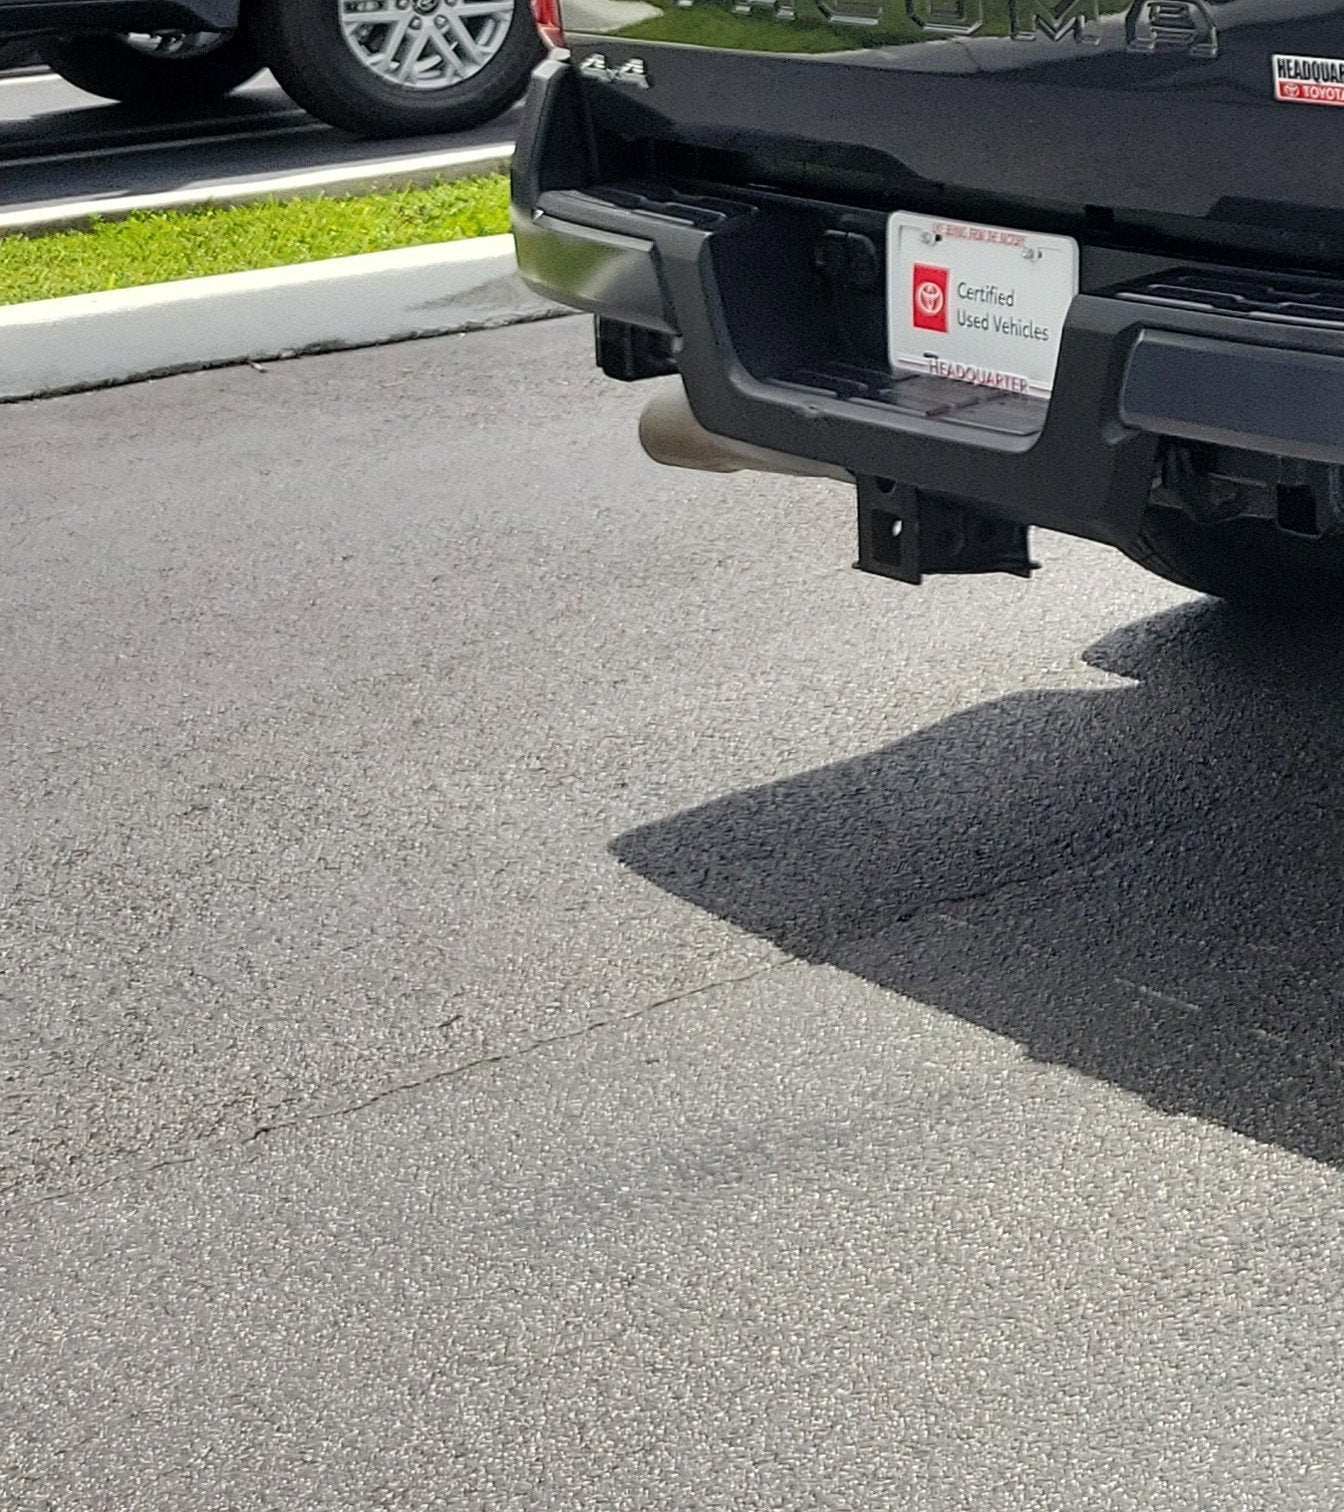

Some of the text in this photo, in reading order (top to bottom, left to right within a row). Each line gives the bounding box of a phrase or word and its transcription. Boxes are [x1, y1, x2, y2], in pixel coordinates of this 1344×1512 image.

[957, 281, 1015, 307] Certified
[957, 309, 1050, 341] Used Vehicles
[929, 359, 1028, 393] HEADQUARTER
